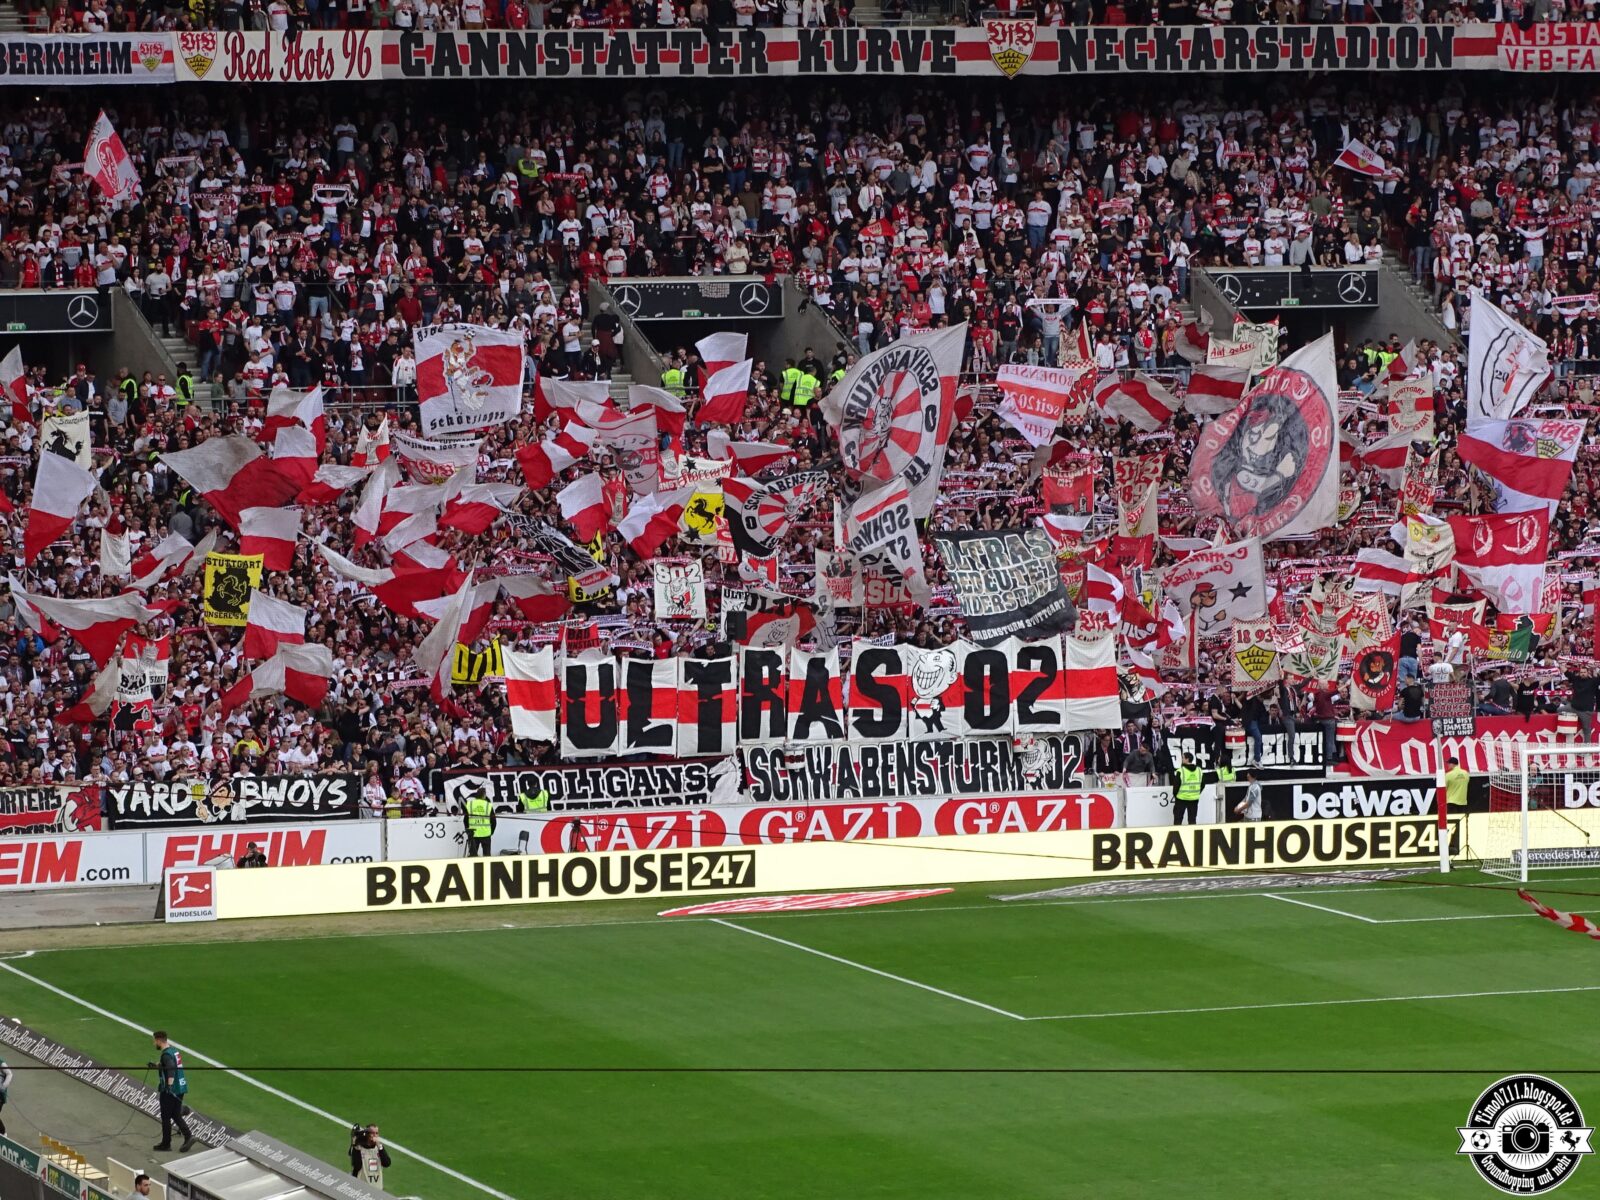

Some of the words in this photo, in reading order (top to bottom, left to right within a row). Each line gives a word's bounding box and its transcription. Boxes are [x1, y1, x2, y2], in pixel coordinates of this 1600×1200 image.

[223, 31, 274, 81] Red
[280, 30, 335, 81] Hots
[342, 30, 372, 79] 96
[401, 29, 769, 78] CANNSTATTER
[799, 28, 956, 74] KURVE
[1057, 25, 1455, 72] NECKARSTADION
[206, 557, 261, 569] STUTTGART
[936, 530, 1052, 572] ULTRAS
[1236, 629, 1251, 643] 18
[564, 647, 902, 753] ULTRAS
[963, 645, 1062, 732] 02
[110, 780, 191, 816] YARD
[240, 778, 348, 810] BWOYS
[1293, 784, 1437, 819] betway
[424, 823, 446, 839] 33
[170, 910, 213, 918] BUNDESLIGA
[369, 1175, 379, 1183] TV
